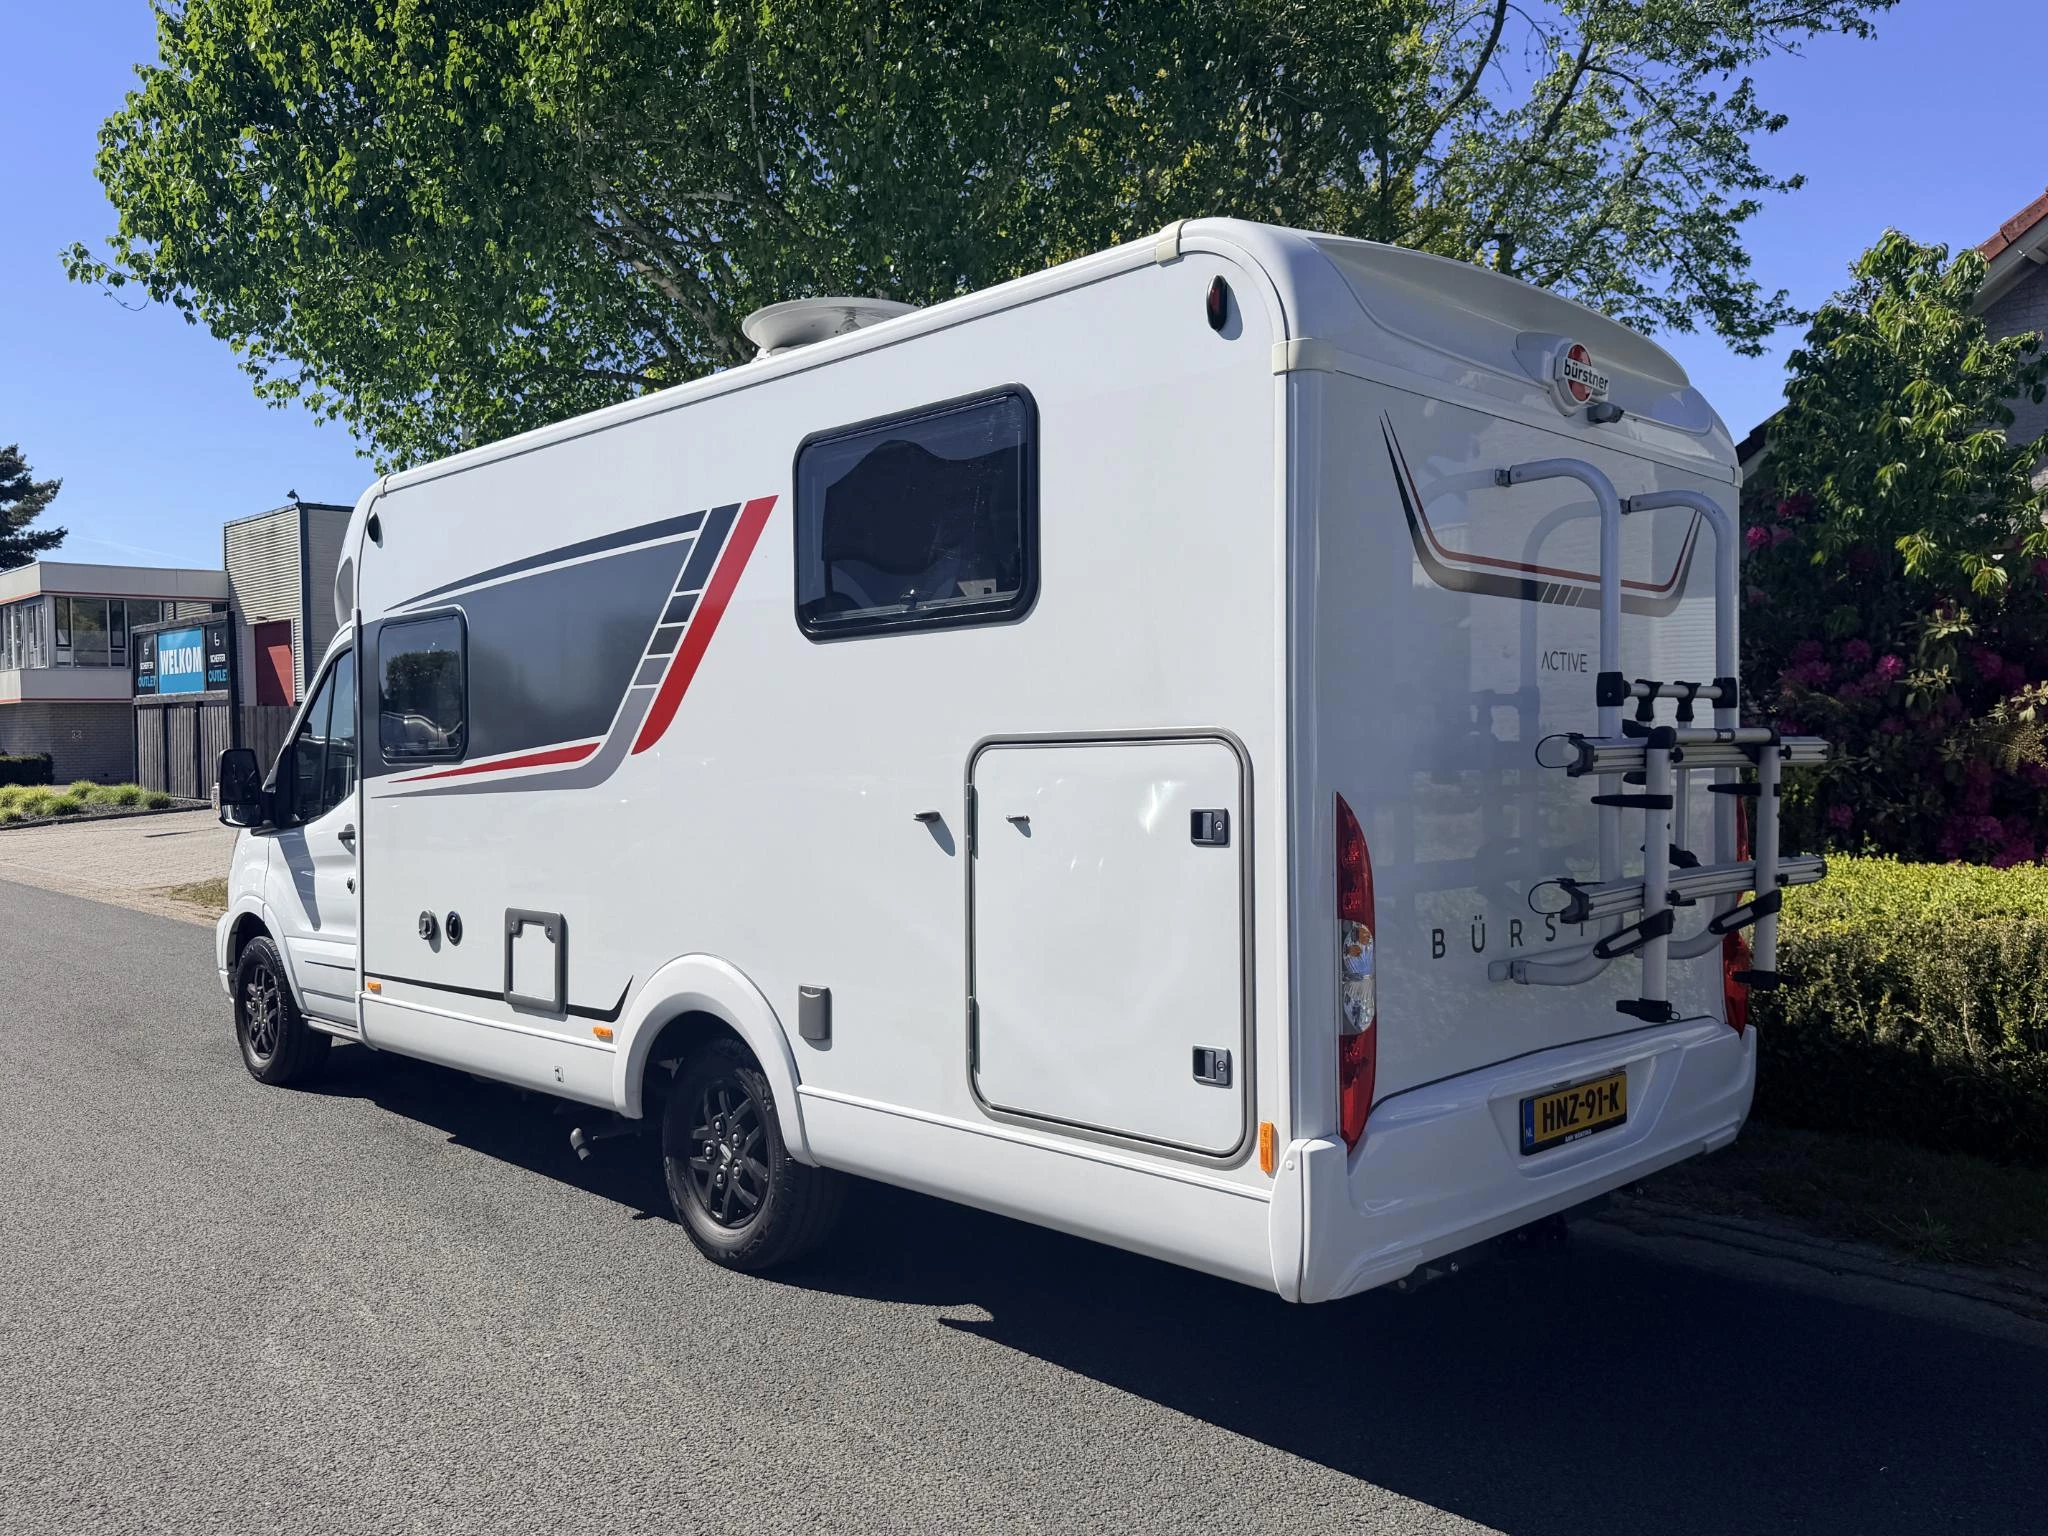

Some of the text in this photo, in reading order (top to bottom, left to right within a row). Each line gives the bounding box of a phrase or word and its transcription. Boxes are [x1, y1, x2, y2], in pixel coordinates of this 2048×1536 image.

[1564, 359, 1608, 390] bürstner
[160, 647, 202, 675] WELKOM
[1541, 650, 1588, 673] ACTIVE
[137, 675, 156, 688] OUTLET
[1542, 1082, 1619, 1134] HNZ-91-K
[1525, 1127, 1533, 1137] NL
